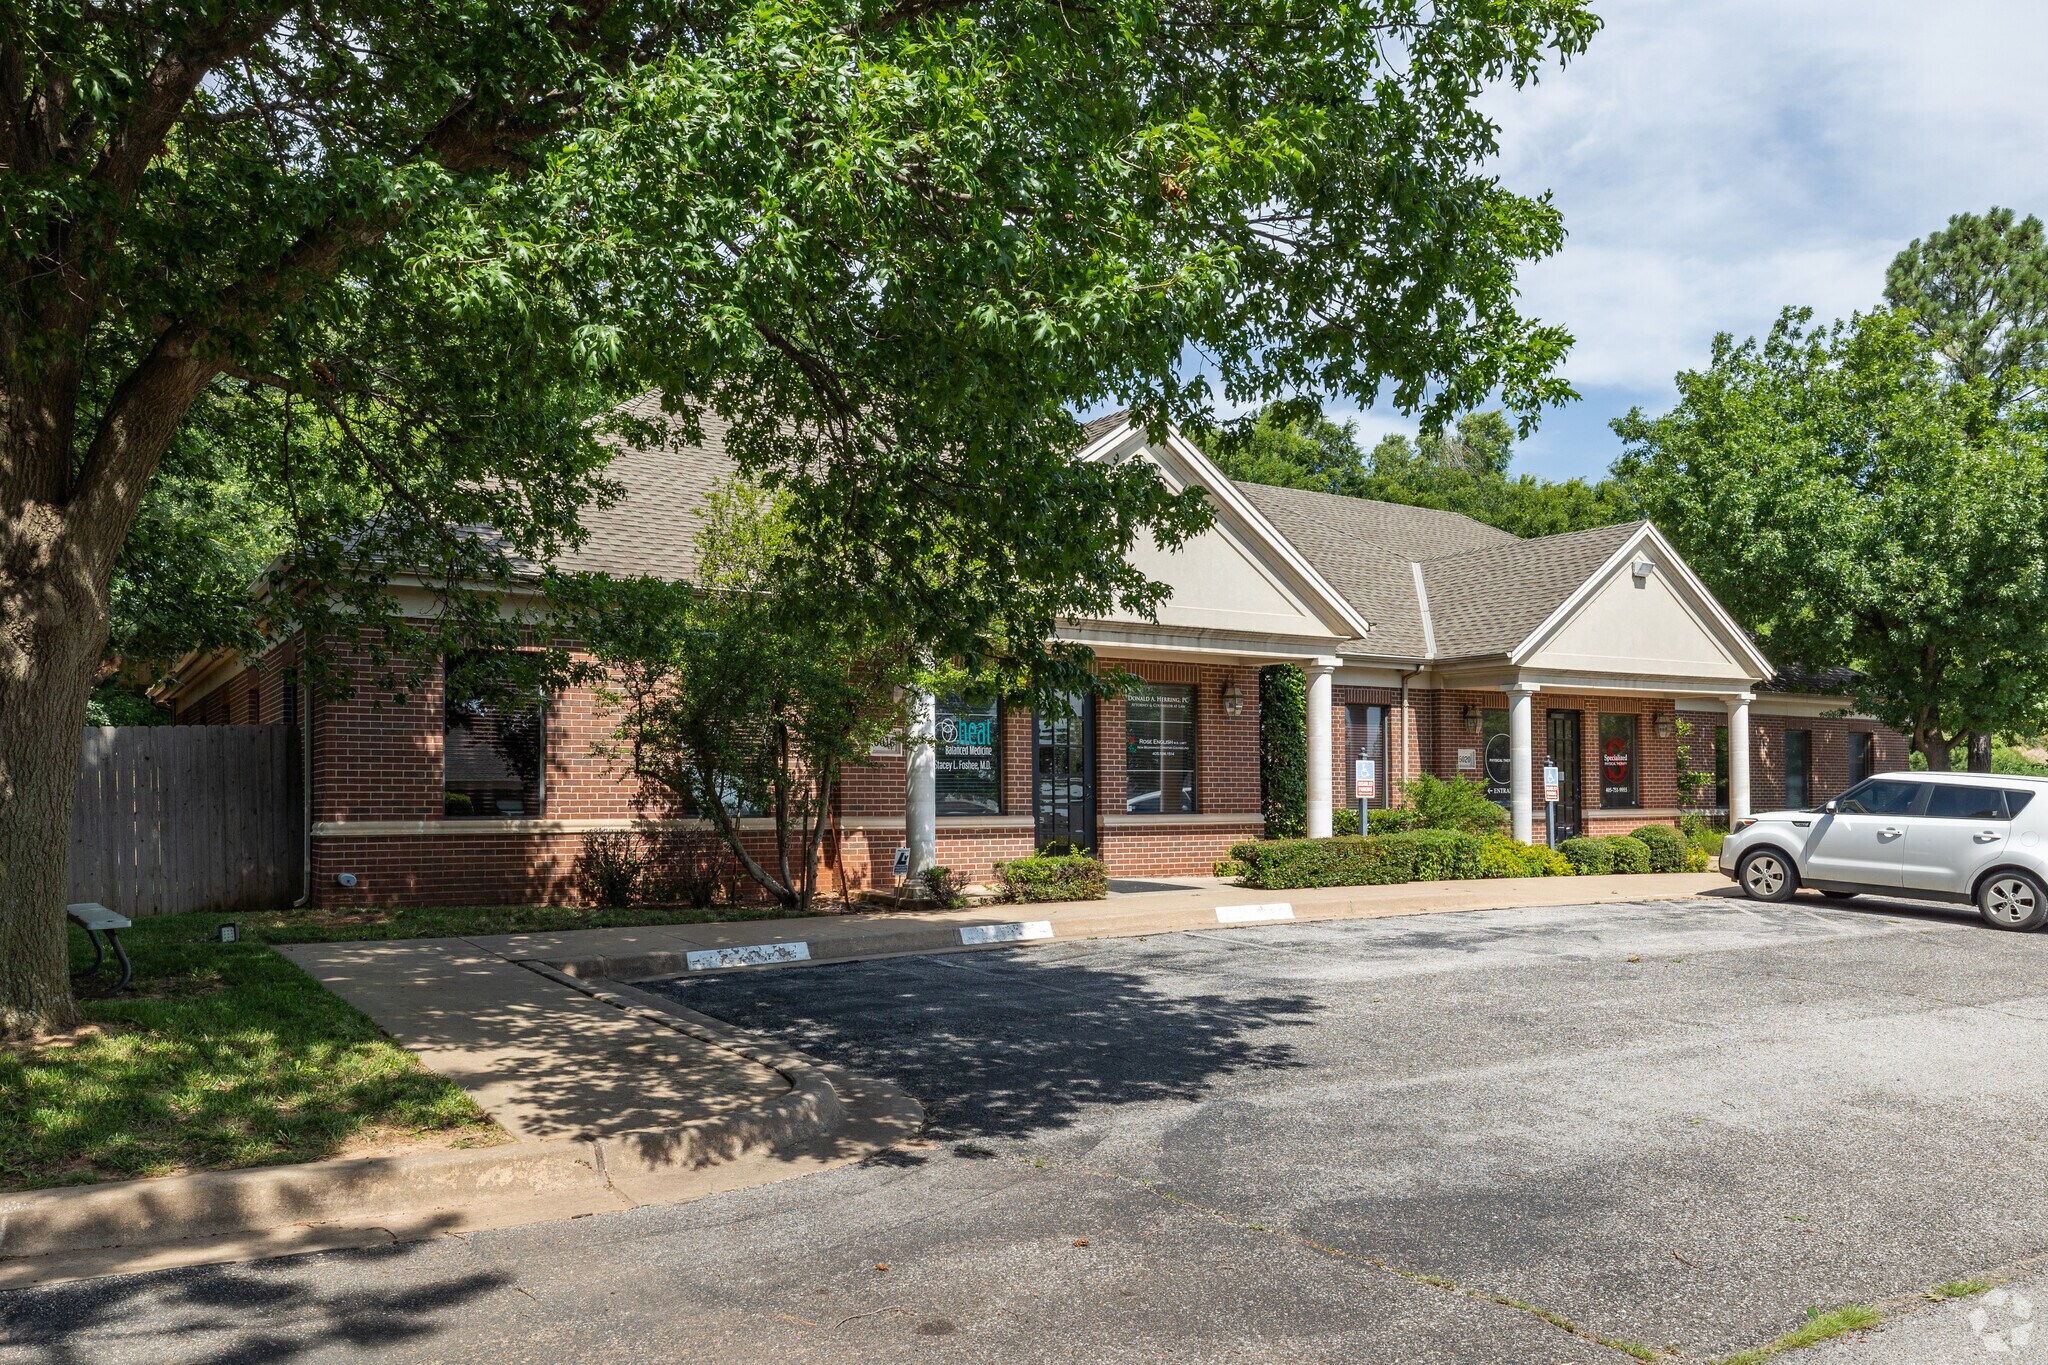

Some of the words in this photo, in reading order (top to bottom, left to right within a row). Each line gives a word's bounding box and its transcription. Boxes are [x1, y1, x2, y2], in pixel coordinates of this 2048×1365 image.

[958, 719, 991, 745] heal
[945, 745, 968, 755] Balanced
[969, 746, 992, 755] Medicine
[935, 760, 952, 771] Stacey
[980, 761, 991, 770] M.D.
